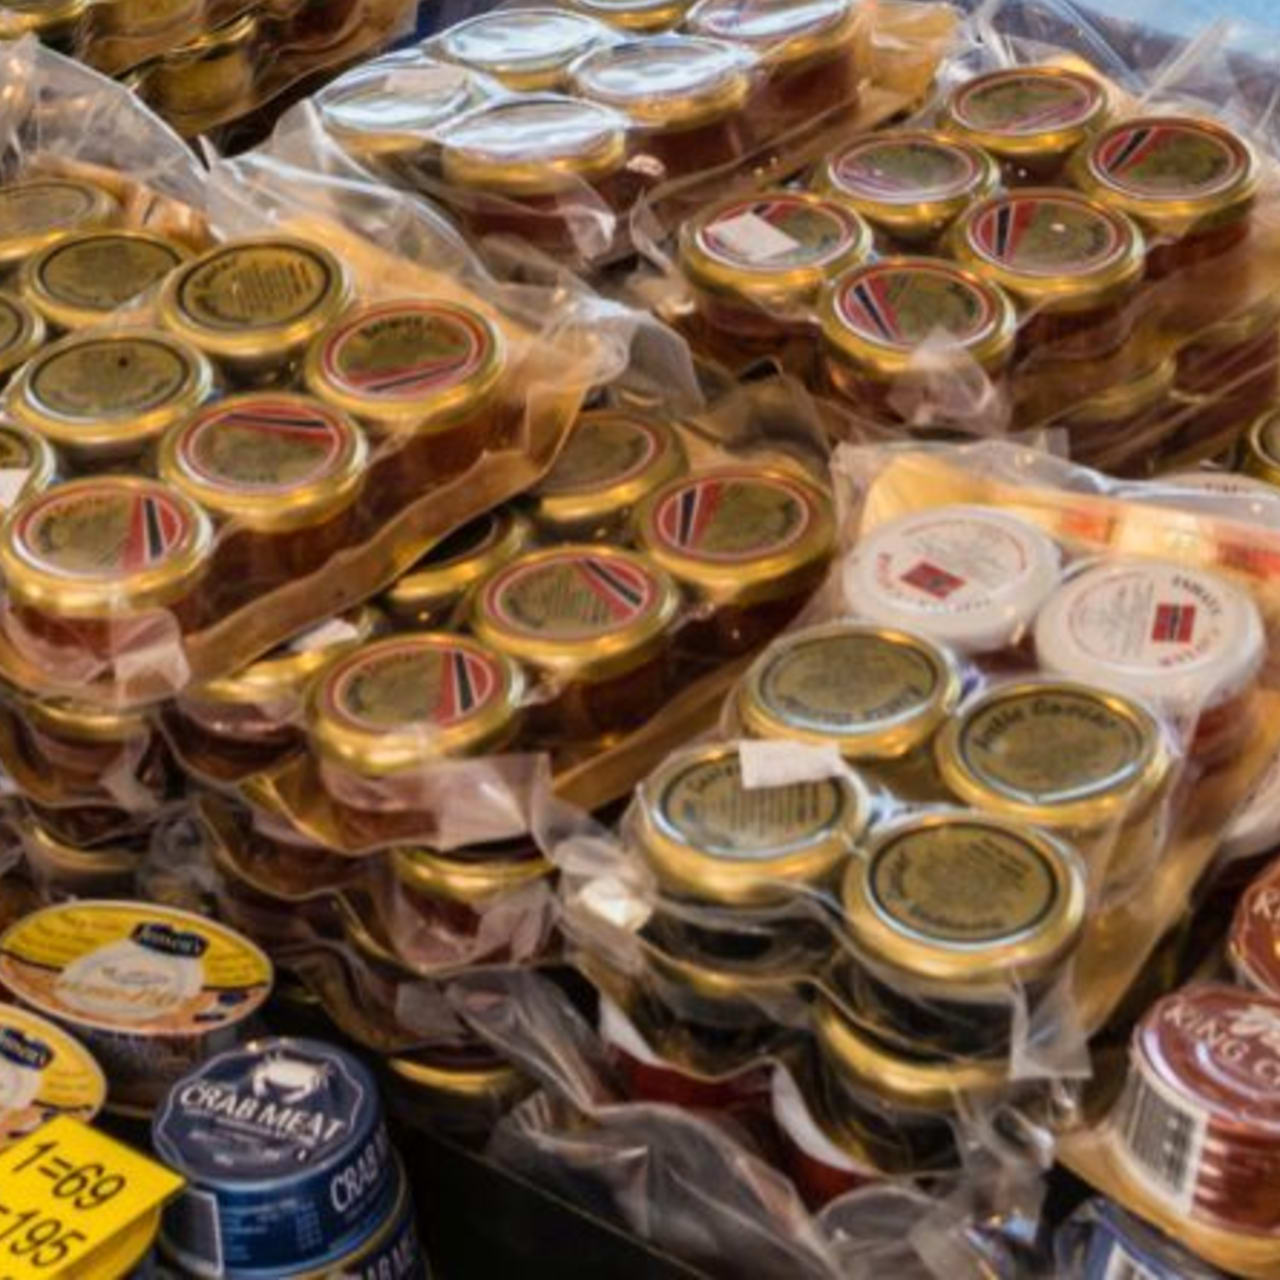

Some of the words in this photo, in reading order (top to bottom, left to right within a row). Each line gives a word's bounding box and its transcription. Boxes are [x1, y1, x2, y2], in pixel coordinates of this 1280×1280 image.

[1164, 1000, 1251, 1062] KING
[180, 1080, 259, 1122] CRAB
[257, 1100, 346, 1148] MEAT
[11, 1138, 127, 1212] 1=69
